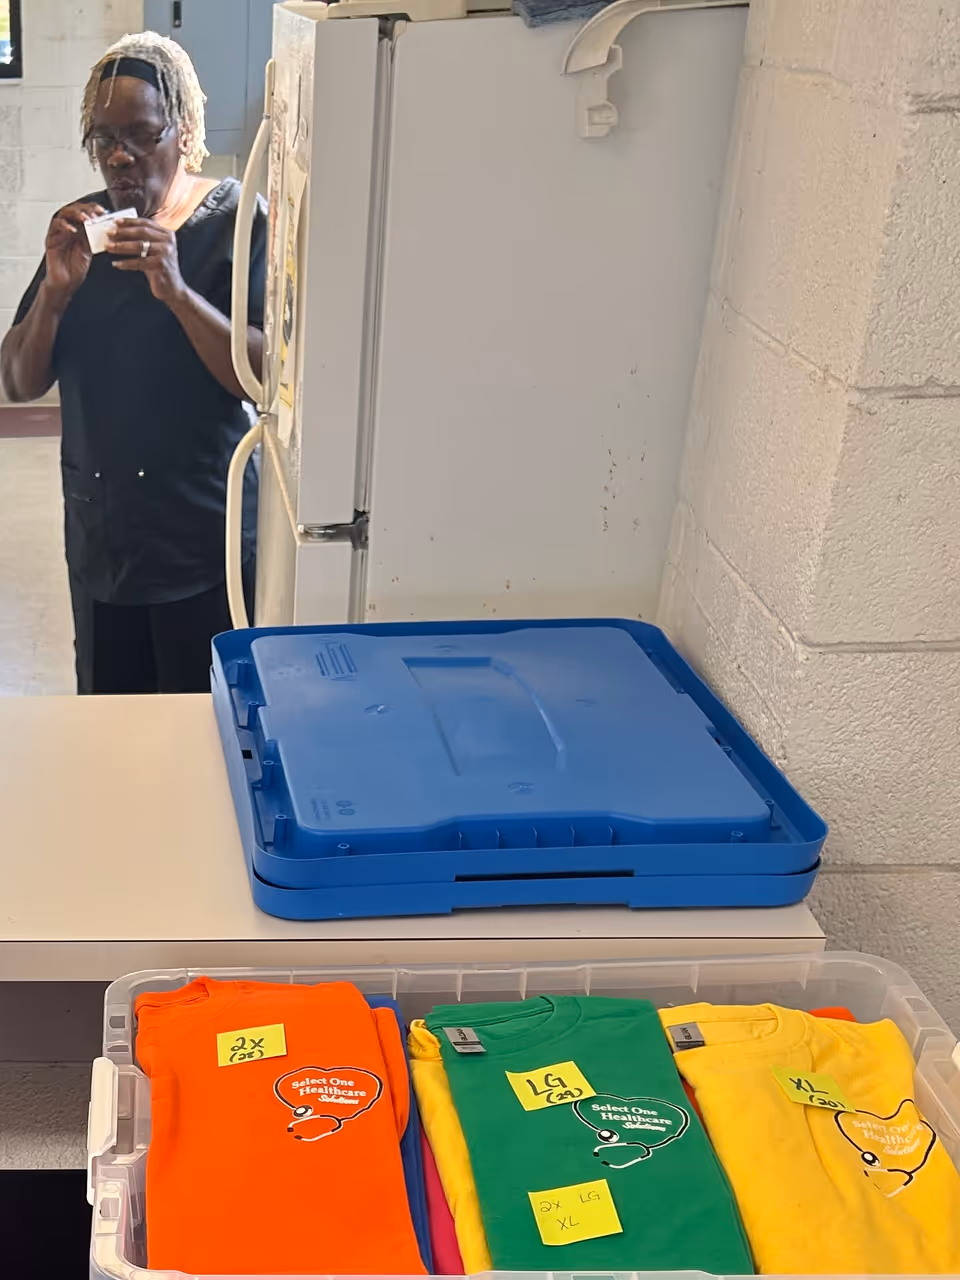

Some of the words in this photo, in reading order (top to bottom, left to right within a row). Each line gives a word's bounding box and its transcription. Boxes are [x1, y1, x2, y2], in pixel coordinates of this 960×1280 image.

[292, 1078, 327, 1089] Select
[329, 1078, 354, 1087] One
[526, 1073, 567, 1096] LG
[789, 1077, 829, 1095] XL
[299, 1086, 367, 1096] Healthcare
[591, 1104, 629, 1112] Select
[631, 1107, 658, 1115] One
[601, 1113, 672, 1125] Healthcare
[580, 1191, 600, 1203] LG
[556, 1216, 580, 1231] XL
